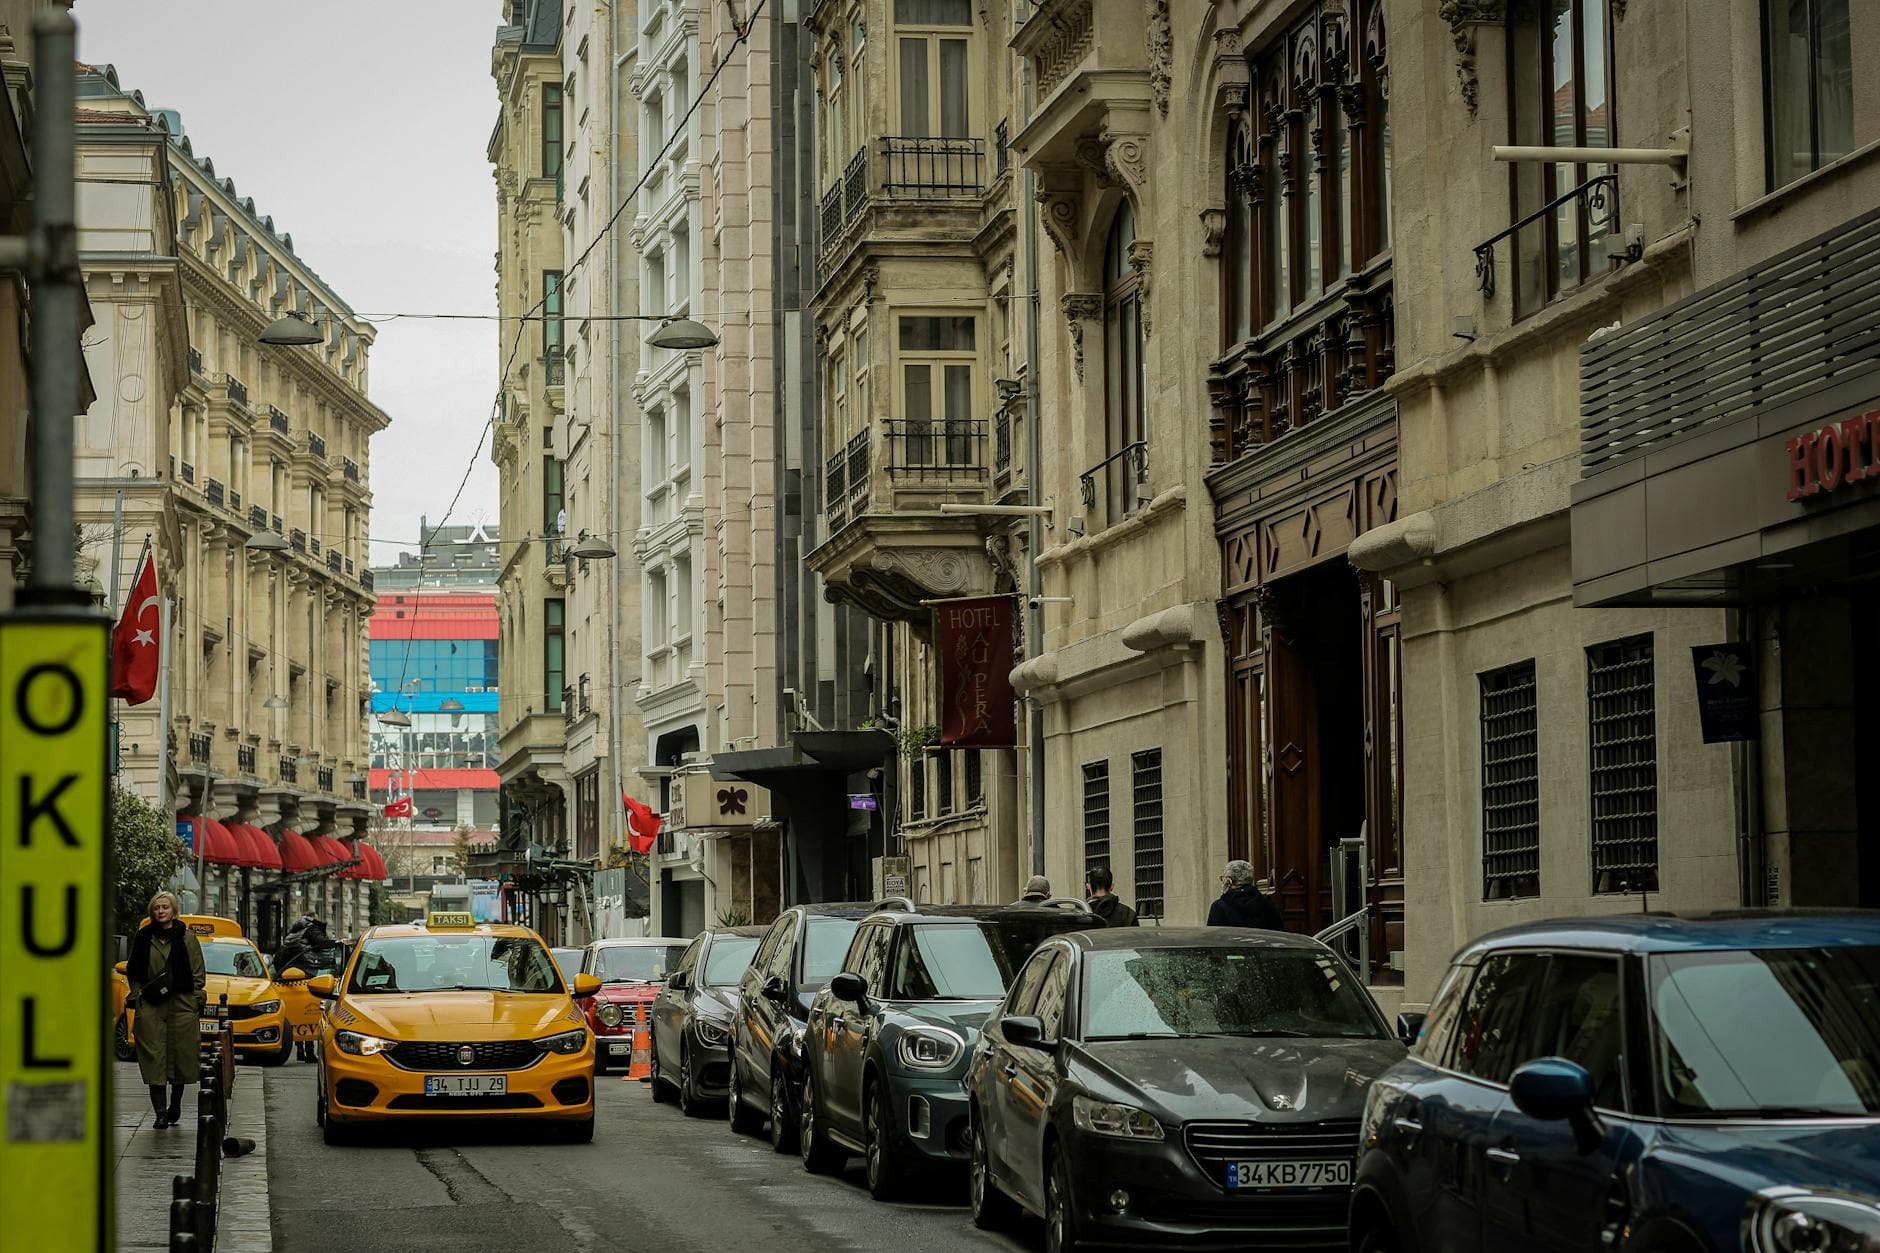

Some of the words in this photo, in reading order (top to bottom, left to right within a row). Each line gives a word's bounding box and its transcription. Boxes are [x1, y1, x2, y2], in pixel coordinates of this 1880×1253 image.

[950, 606, 1000, 630] HOTEL
[14, 661, 85, 1070] OKUL
[433, 1078, 448, 1091] 34
[457, 1078, 480, 1091] TJJ
[489, 1077, 504, 1091] 29
